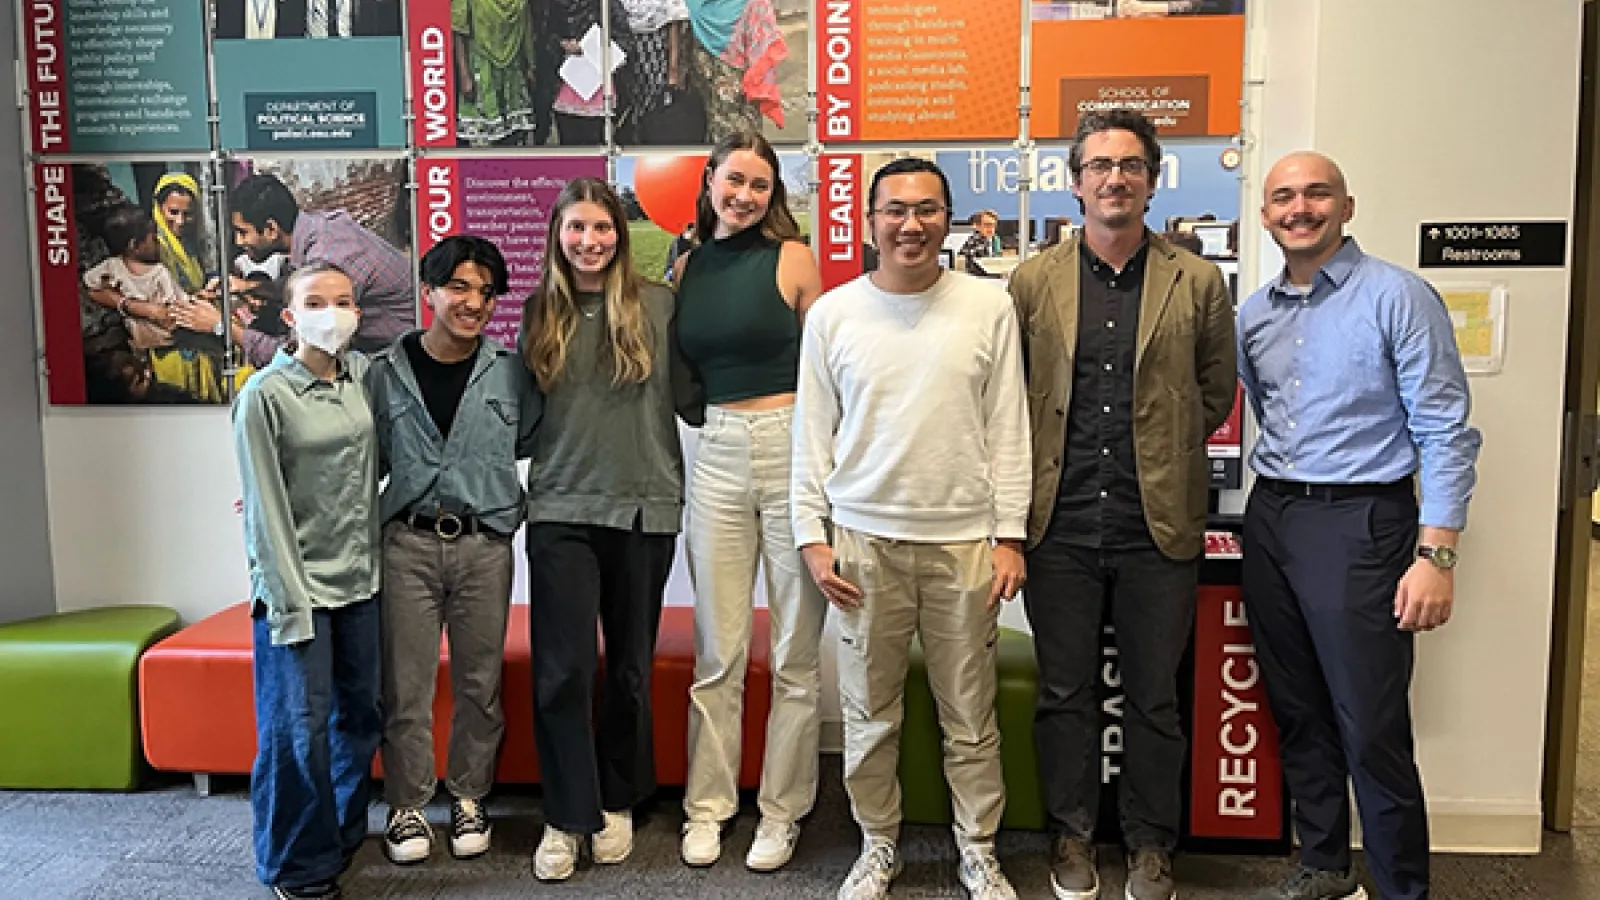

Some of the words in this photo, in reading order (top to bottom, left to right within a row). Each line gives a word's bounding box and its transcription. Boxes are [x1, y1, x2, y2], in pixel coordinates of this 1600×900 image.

[40, 91, 62, 149] THE
[256, 113, 316, 125] POLITICAL
[317, 112, 366, 125] SCIENCE
[421, 26, 448, 141] WORLD
[827, 93, 851, 136] BY
[1098, 86, 1150, 98] SCHOOL
[1152, 86, 1170, 98] OF
[43, 166, 69, 266] SHAPE
[829, 158, 853, 261] LEARN
[1218, 601, 1259, 817] RECYCLE
